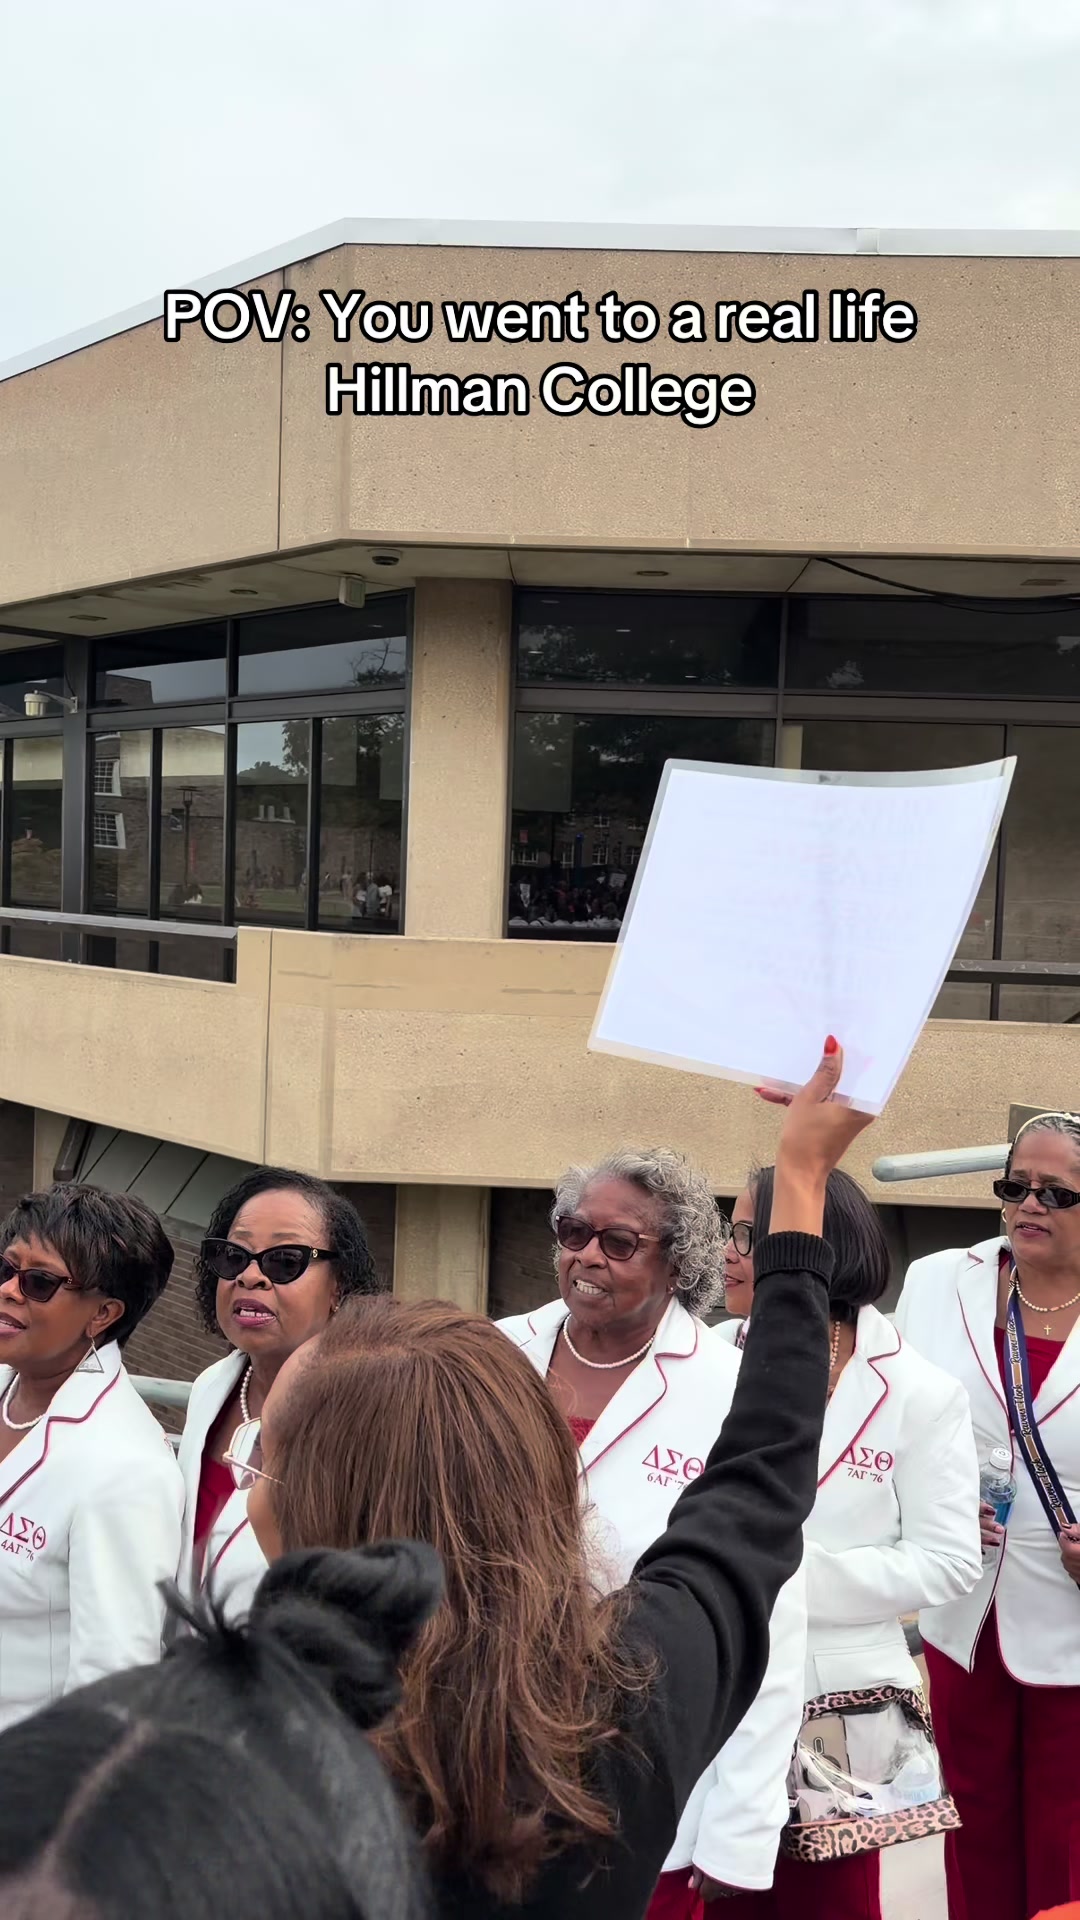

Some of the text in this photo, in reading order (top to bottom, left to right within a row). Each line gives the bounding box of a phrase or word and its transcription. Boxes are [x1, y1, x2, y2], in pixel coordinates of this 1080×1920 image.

[1020, 1408, 1032, 1438] Ravens
[642, 1444, 705, 1481] ΔΣΘ
[840, 1445, 894, 1472] ΔΣΘ
[869, 1472, 883, 1484] '76
[0, 1512, 46, 1551] ΔΣΘ
